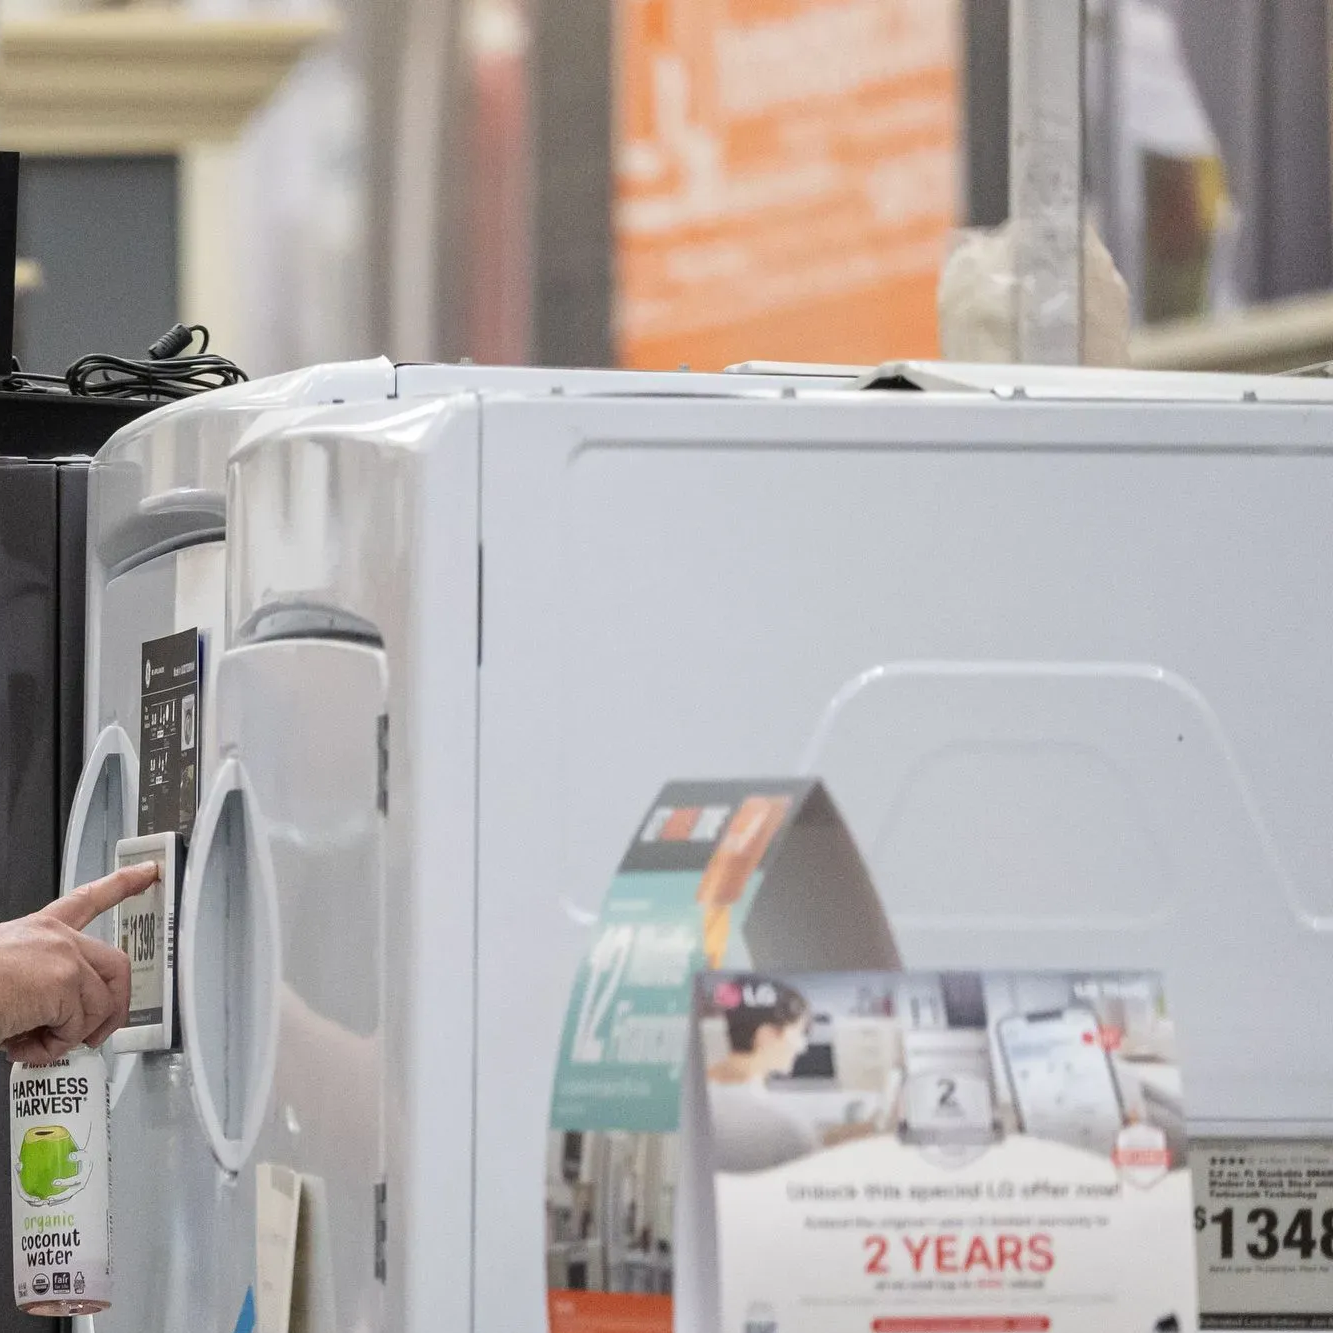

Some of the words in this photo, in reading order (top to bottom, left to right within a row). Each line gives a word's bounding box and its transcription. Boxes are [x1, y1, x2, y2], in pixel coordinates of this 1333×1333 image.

[743, 985, 777, 1007] LG
[12, 1077, 89, 1100] HARMLESS
[935, 1077, 958, 1109] 2
[15, 1096, 84, 1118] HARVEST
[909, 1182, 979, 1204] special
[985, 1182, 1016, 1200] LG
[1021, 1181, 1069, 1200] offer
[23, 1210, 75, 1234] organic
[21, 1228, 81, 1252] coconut
[26, 1247, 73, 1268] water
[863, 1235, 890, 1275] 2
[902, 1233, 1056, 1275] YEARS
[54, 1273, 70, 1284] fair
